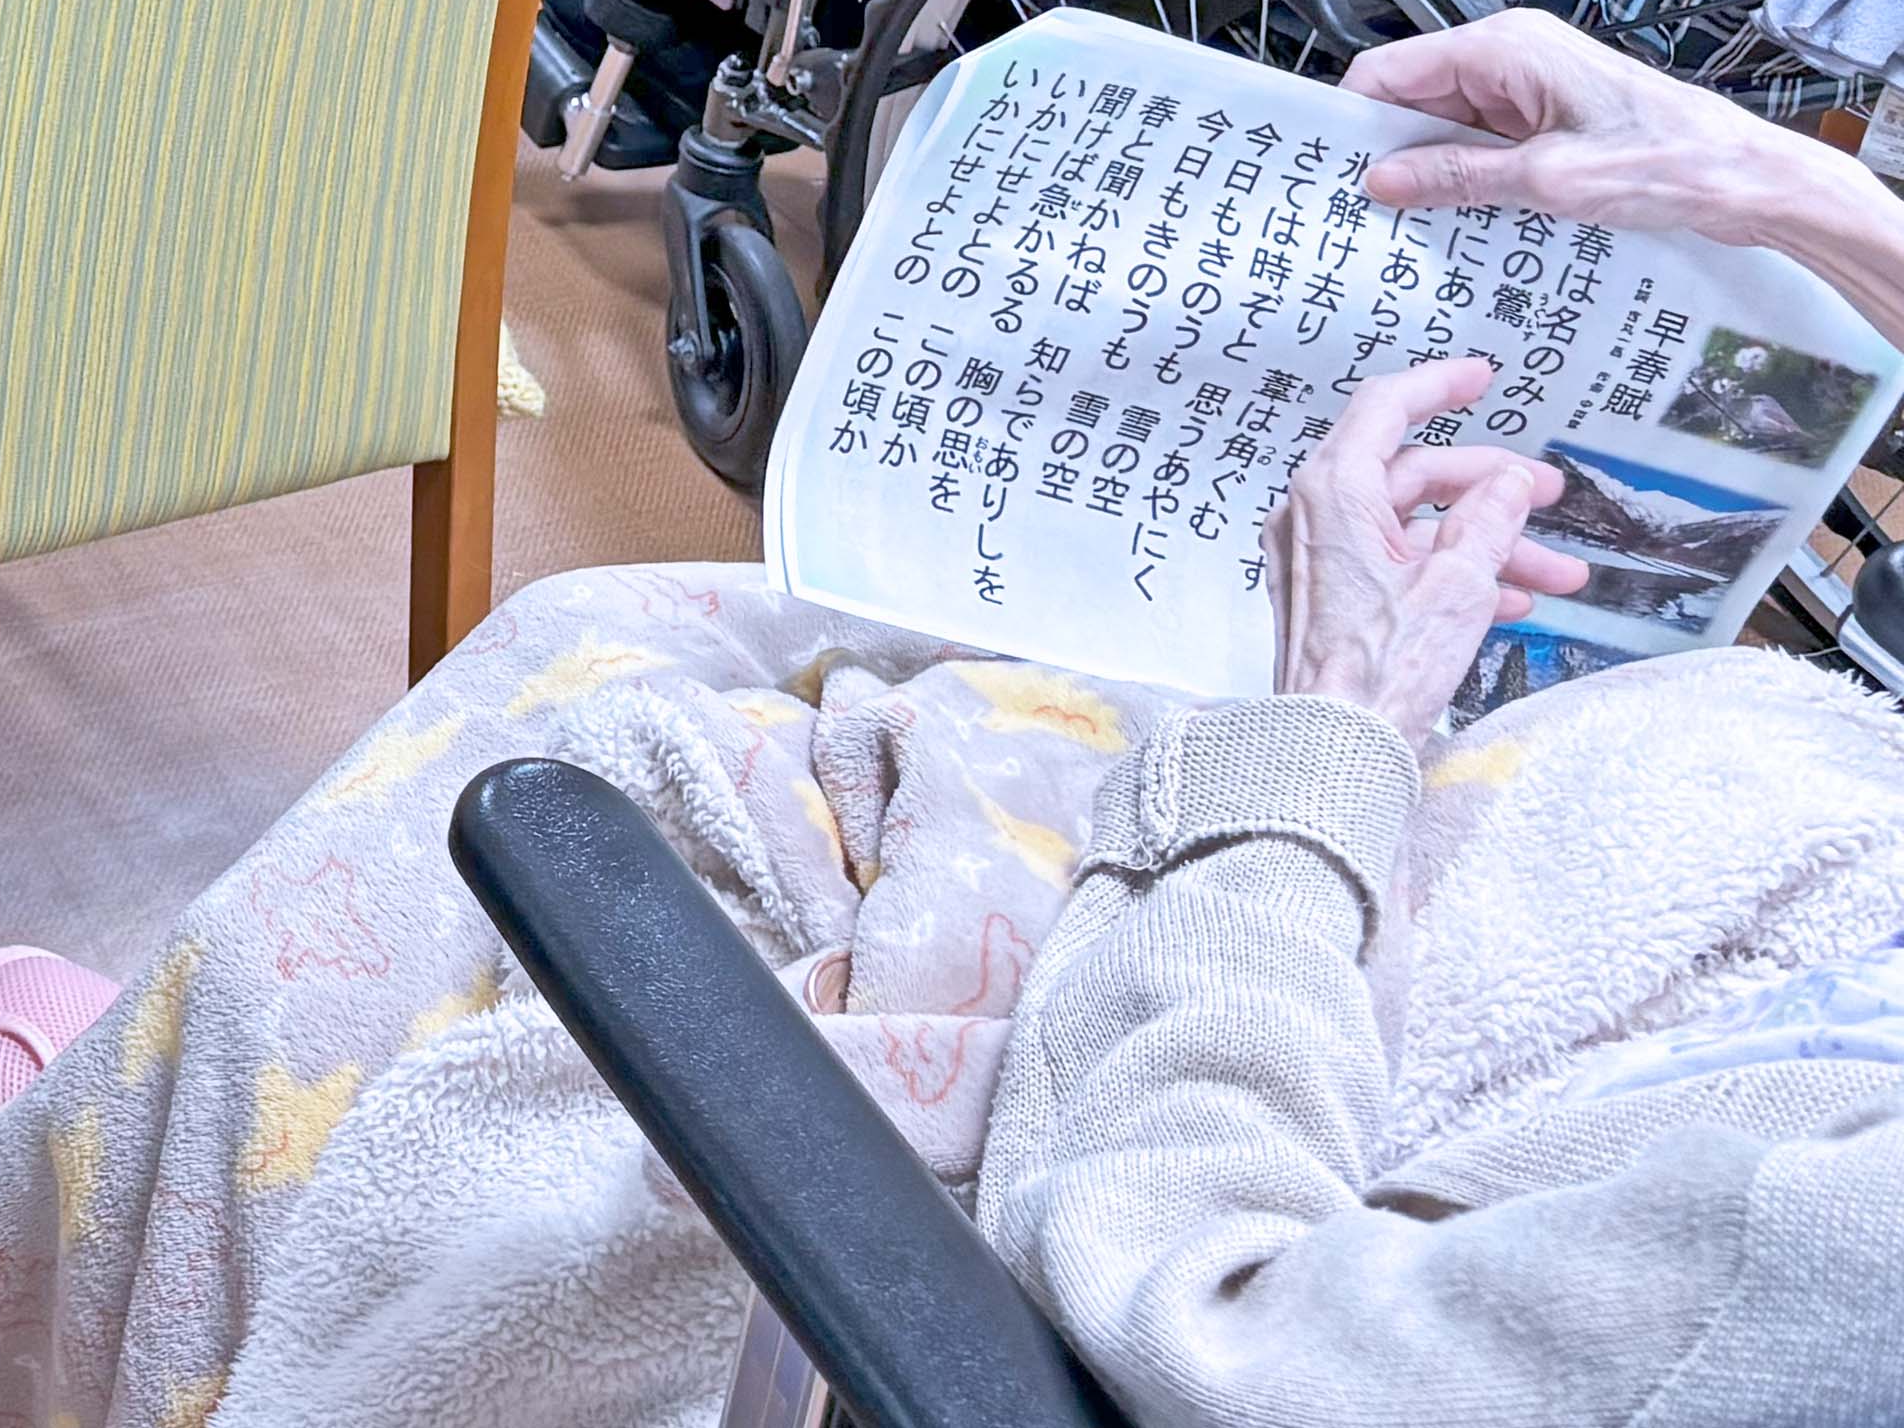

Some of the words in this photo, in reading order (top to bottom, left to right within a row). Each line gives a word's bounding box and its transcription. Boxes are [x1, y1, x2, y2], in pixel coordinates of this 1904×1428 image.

[893, 59, 1039, 285] いかにせよとの
[941, 71, 1085, 299] いかにせよとの
[989, 82, 1137, 334] 聞けば急かるる
[1055, 94, 1183, 314] 春と聞かねば
[1101, 108, 1234, 371] 今日もきのうも
[1153, 122, 1283, 385] 今日もきのうも
[1222, 136, 1330, 364] さては時ぞと
[1485, 206, 1557, 330] 谷の鶯
[828, 311, 905, 455] この頃か
[878, 323, 955, 468] この頃か
[928, 355, 1003, 514] 胸の思を
[1485, 221, 1615, 437] 春は名のみの
[1599, 308, 1690, 422] 早春賦
[974, 335, 1071, 605] 知らでありしを
[1035, 390, 1110, 505] 雪の空
[1085, 404, 1162, 517] 雪の空
[1132, 382, 1231, 602] 思うあやにく
[1188, 368, 1304, 541] 葦は角ぐむ
